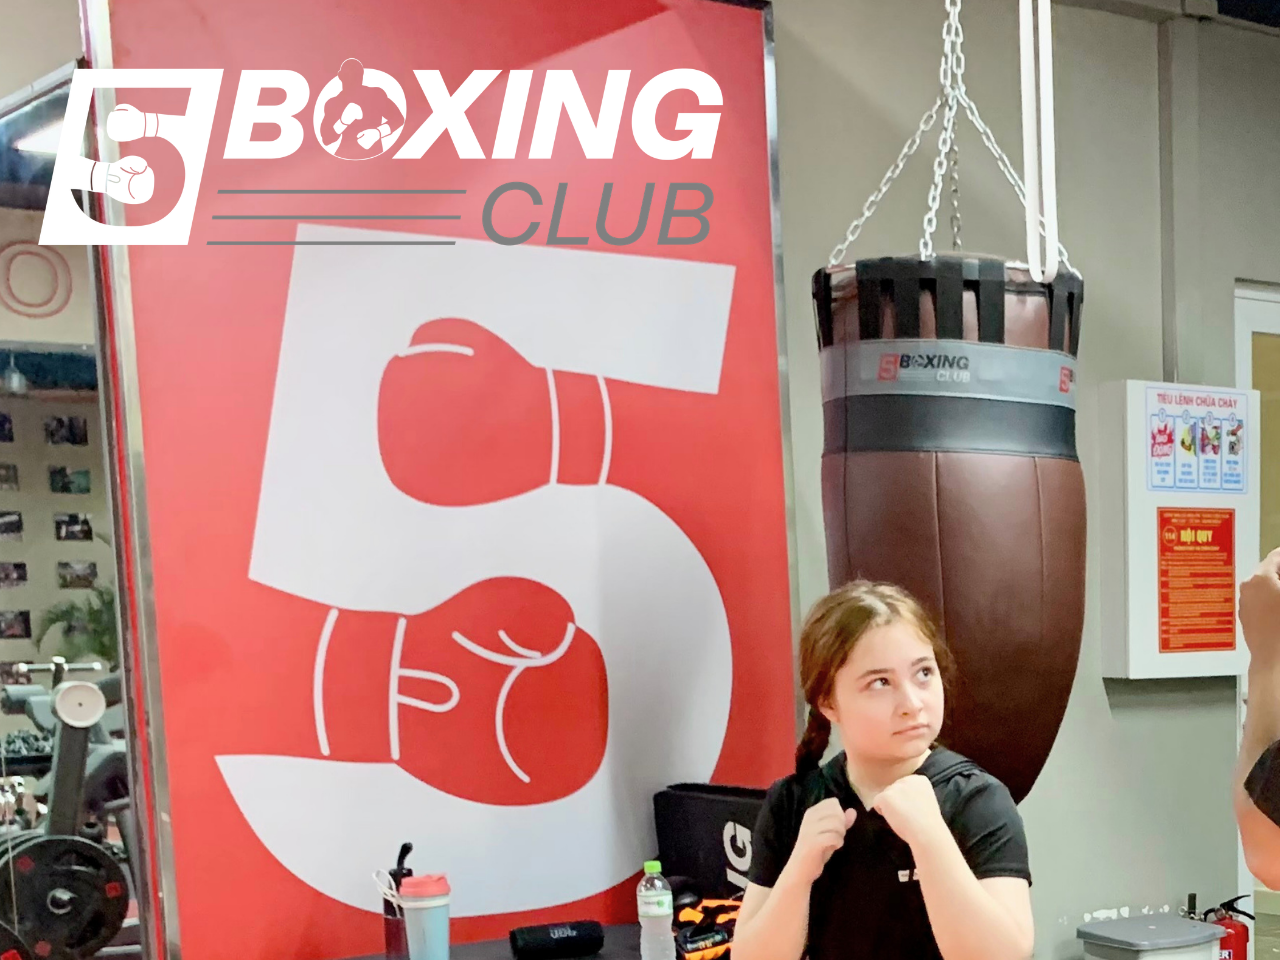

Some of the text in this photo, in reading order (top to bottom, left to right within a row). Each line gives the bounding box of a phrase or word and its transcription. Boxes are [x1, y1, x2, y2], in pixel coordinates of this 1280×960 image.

[880, 354, 970, 381] 5 BOXING
[936, 370, 971, 383] CLUB
[215, 223, 736, 918] 5
